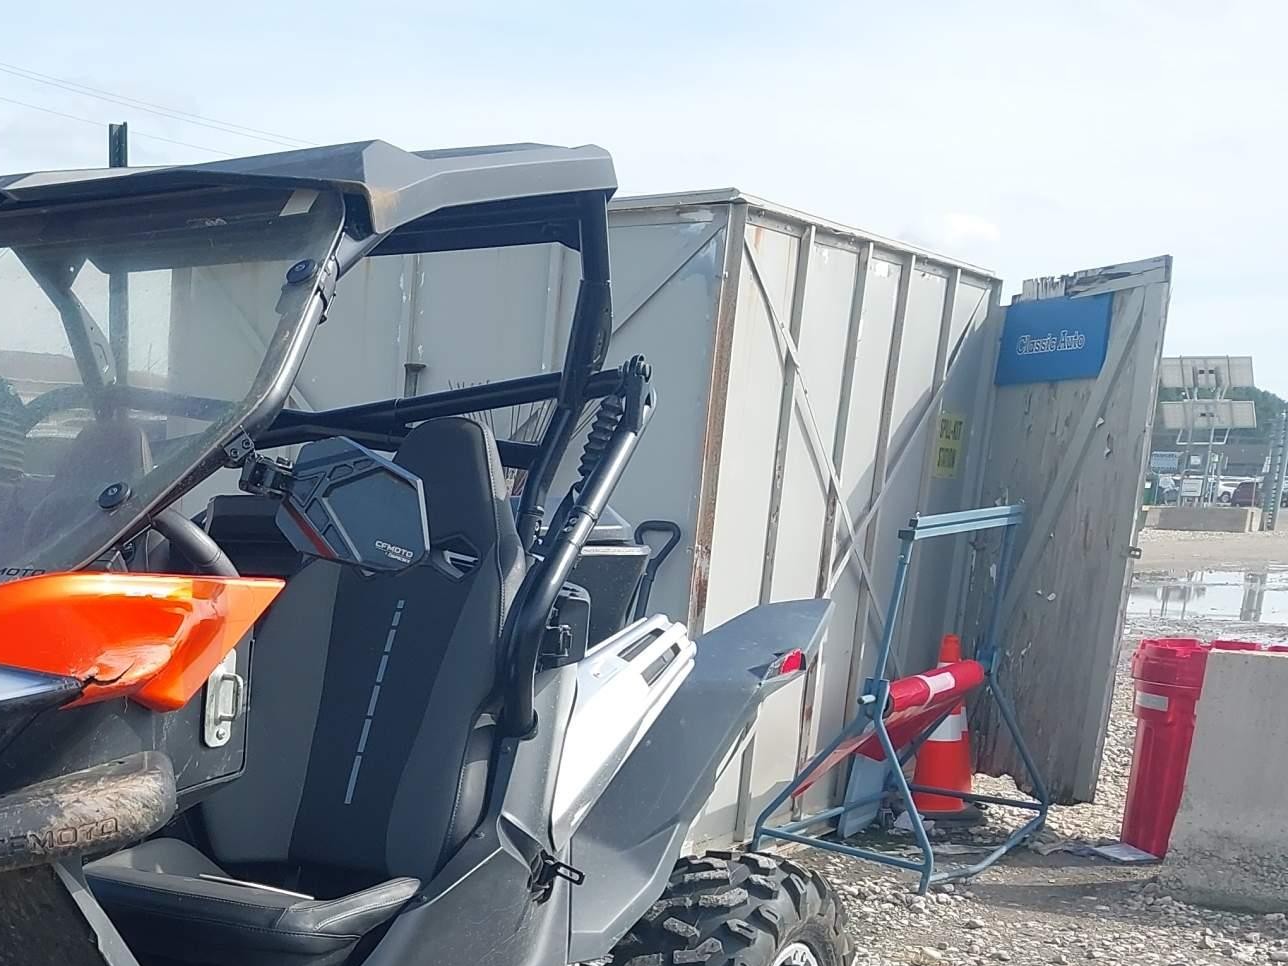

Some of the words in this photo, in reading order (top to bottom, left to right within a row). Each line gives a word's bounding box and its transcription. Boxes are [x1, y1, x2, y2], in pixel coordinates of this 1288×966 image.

[1016, 333, 1057, 355] Classic
[1057, 330, 1085, 350] Auto
[375, 540, 414, 558] CFMOTO
